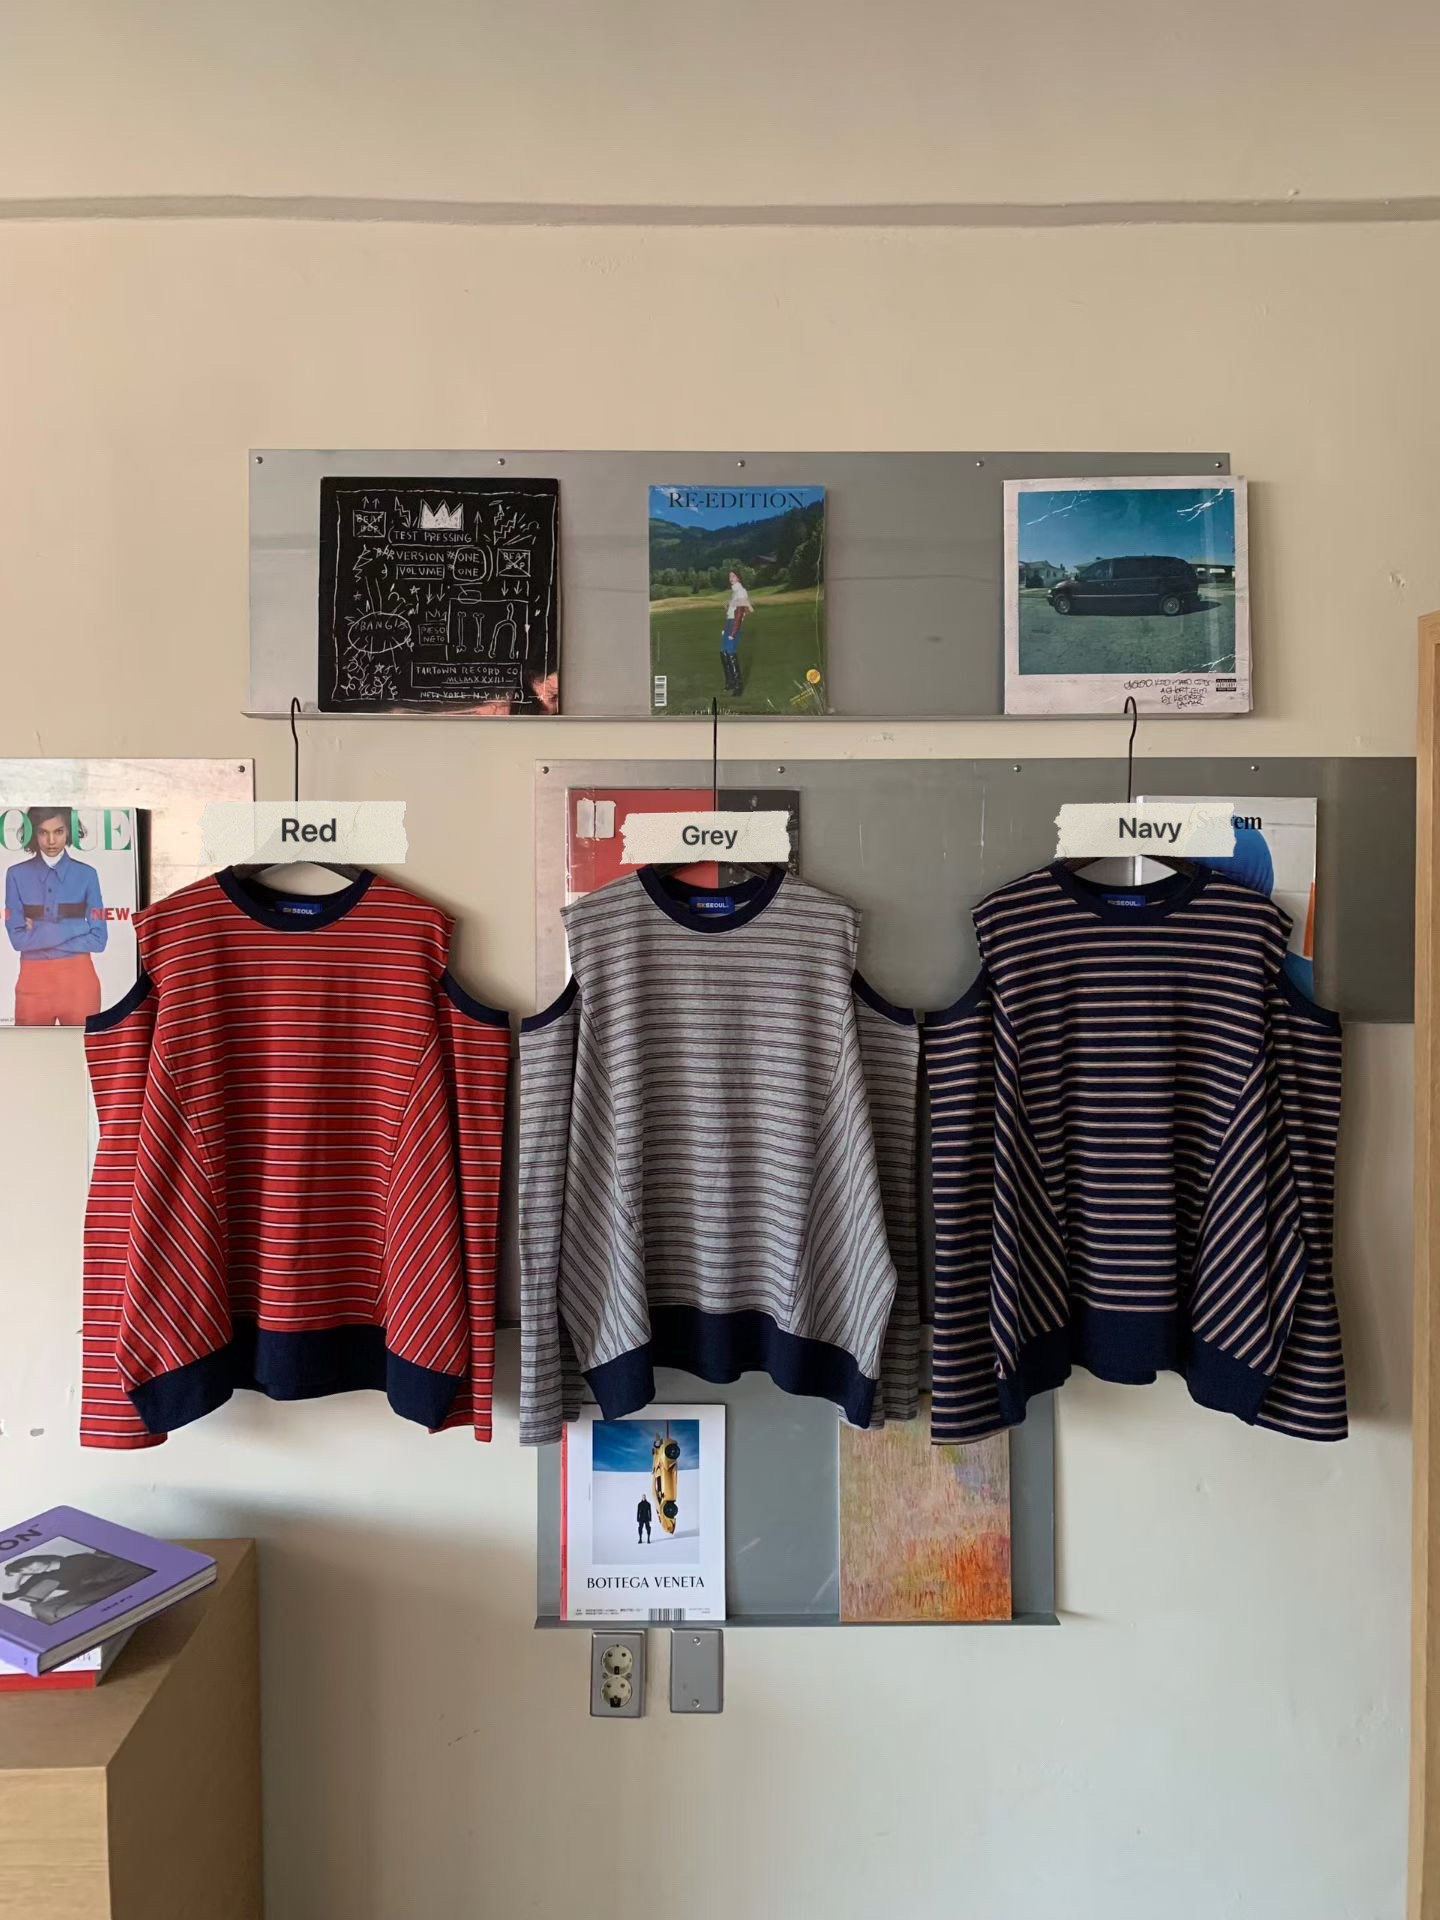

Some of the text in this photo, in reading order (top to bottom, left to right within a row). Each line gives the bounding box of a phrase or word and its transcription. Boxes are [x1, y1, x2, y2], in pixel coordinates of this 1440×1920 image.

[669, 492, 804, 509] RE-EDITION
[424, 531, 473, 543] PRESSING
[396, 550, 445, 562] VERSION
[400, 566, 443, 576] VOLUME
[462, 666, 500, 676] RECORD
[0, 809, 131, 851] OUE
[92, 907, 130, 921] NEW
[587, 1576, 705, 1589] BOTTEGA VENETA
